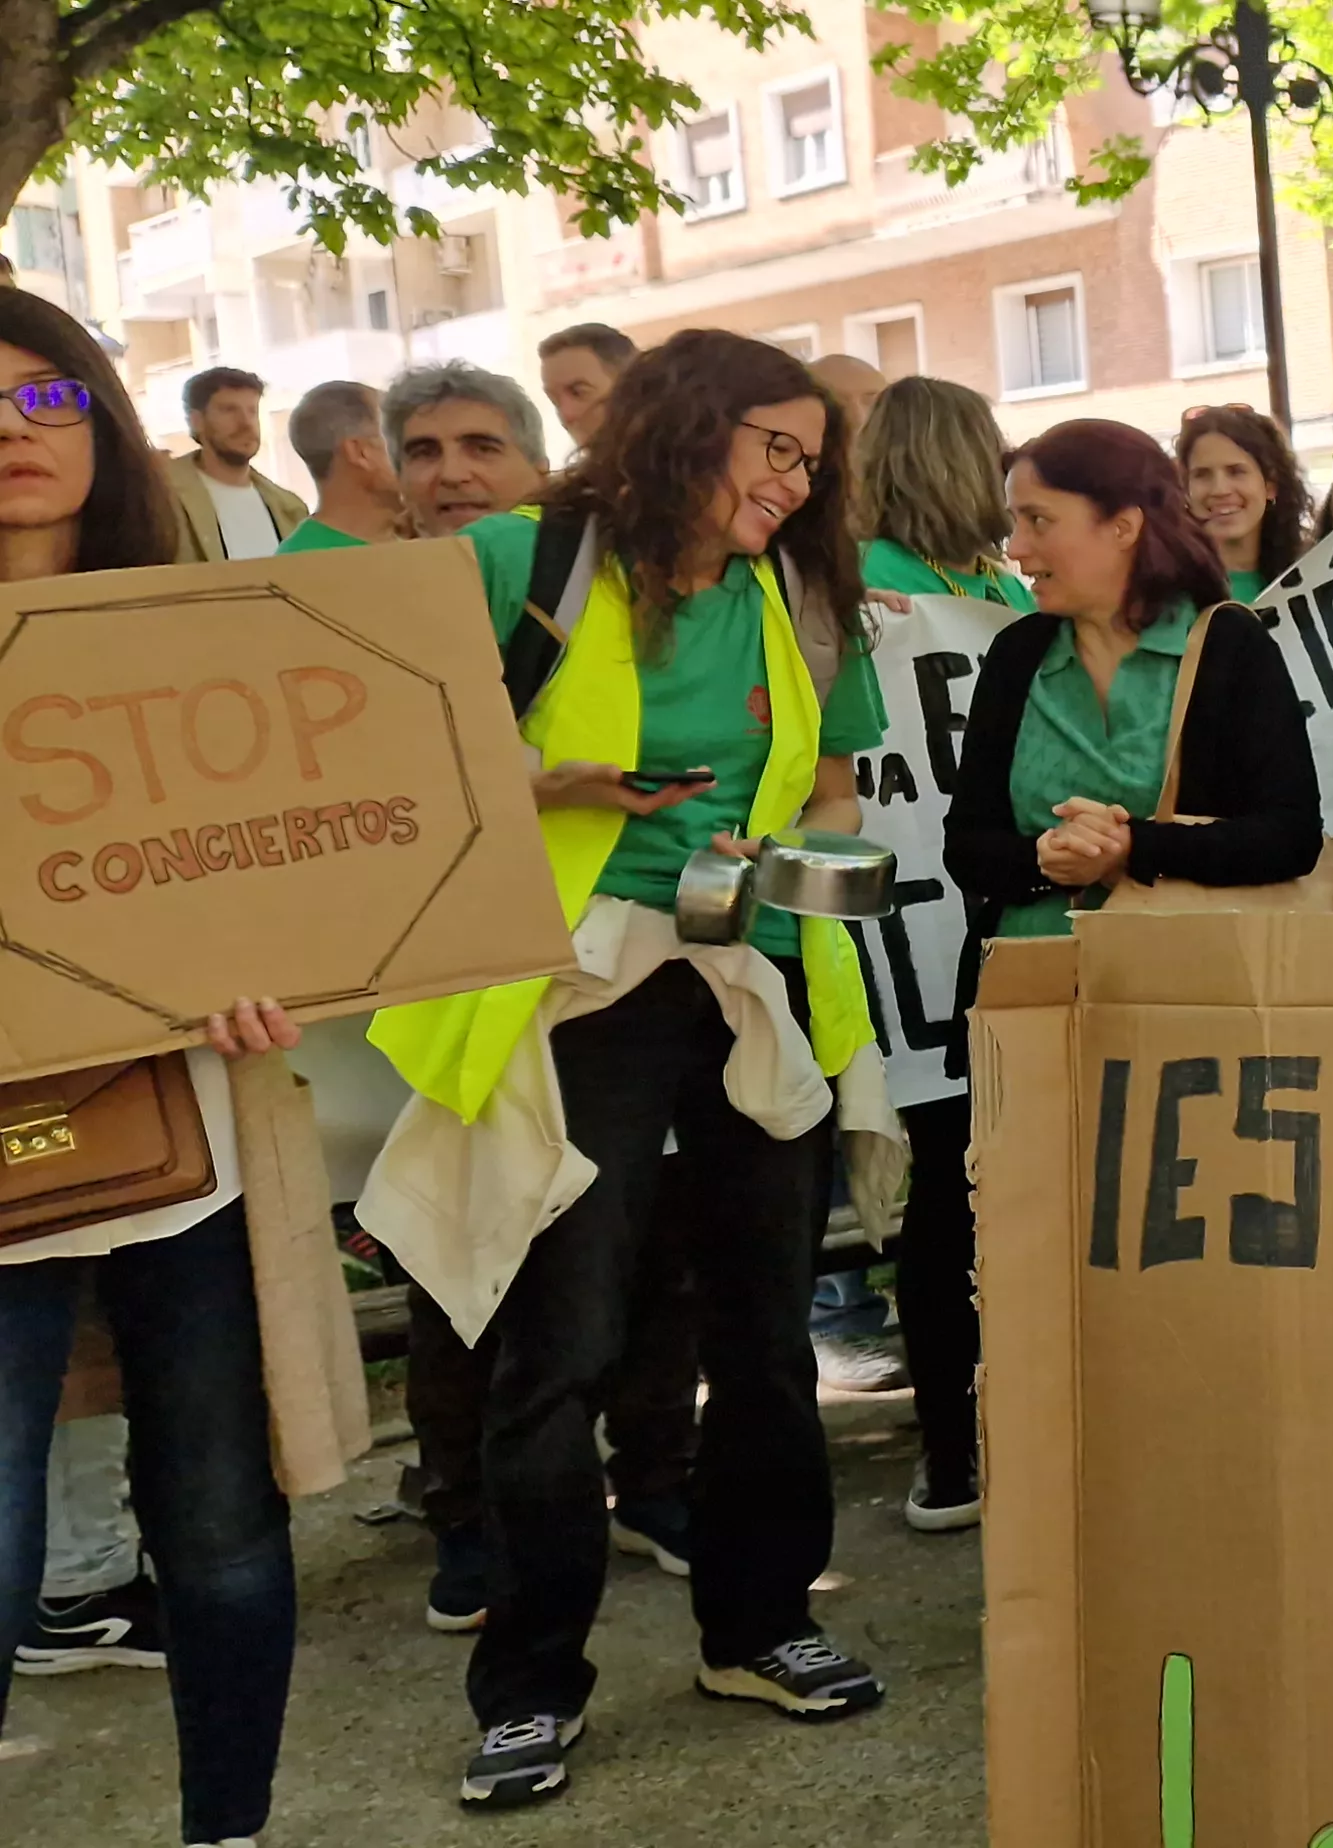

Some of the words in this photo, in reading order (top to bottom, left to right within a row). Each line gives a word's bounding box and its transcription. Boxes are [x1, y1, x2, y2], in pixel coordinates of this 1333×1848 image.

[2, 665, 368, 826] STOP
[37, 796, 420, 902] CONCIERTOS
[1089, 1055, 1321, 1271] IES
